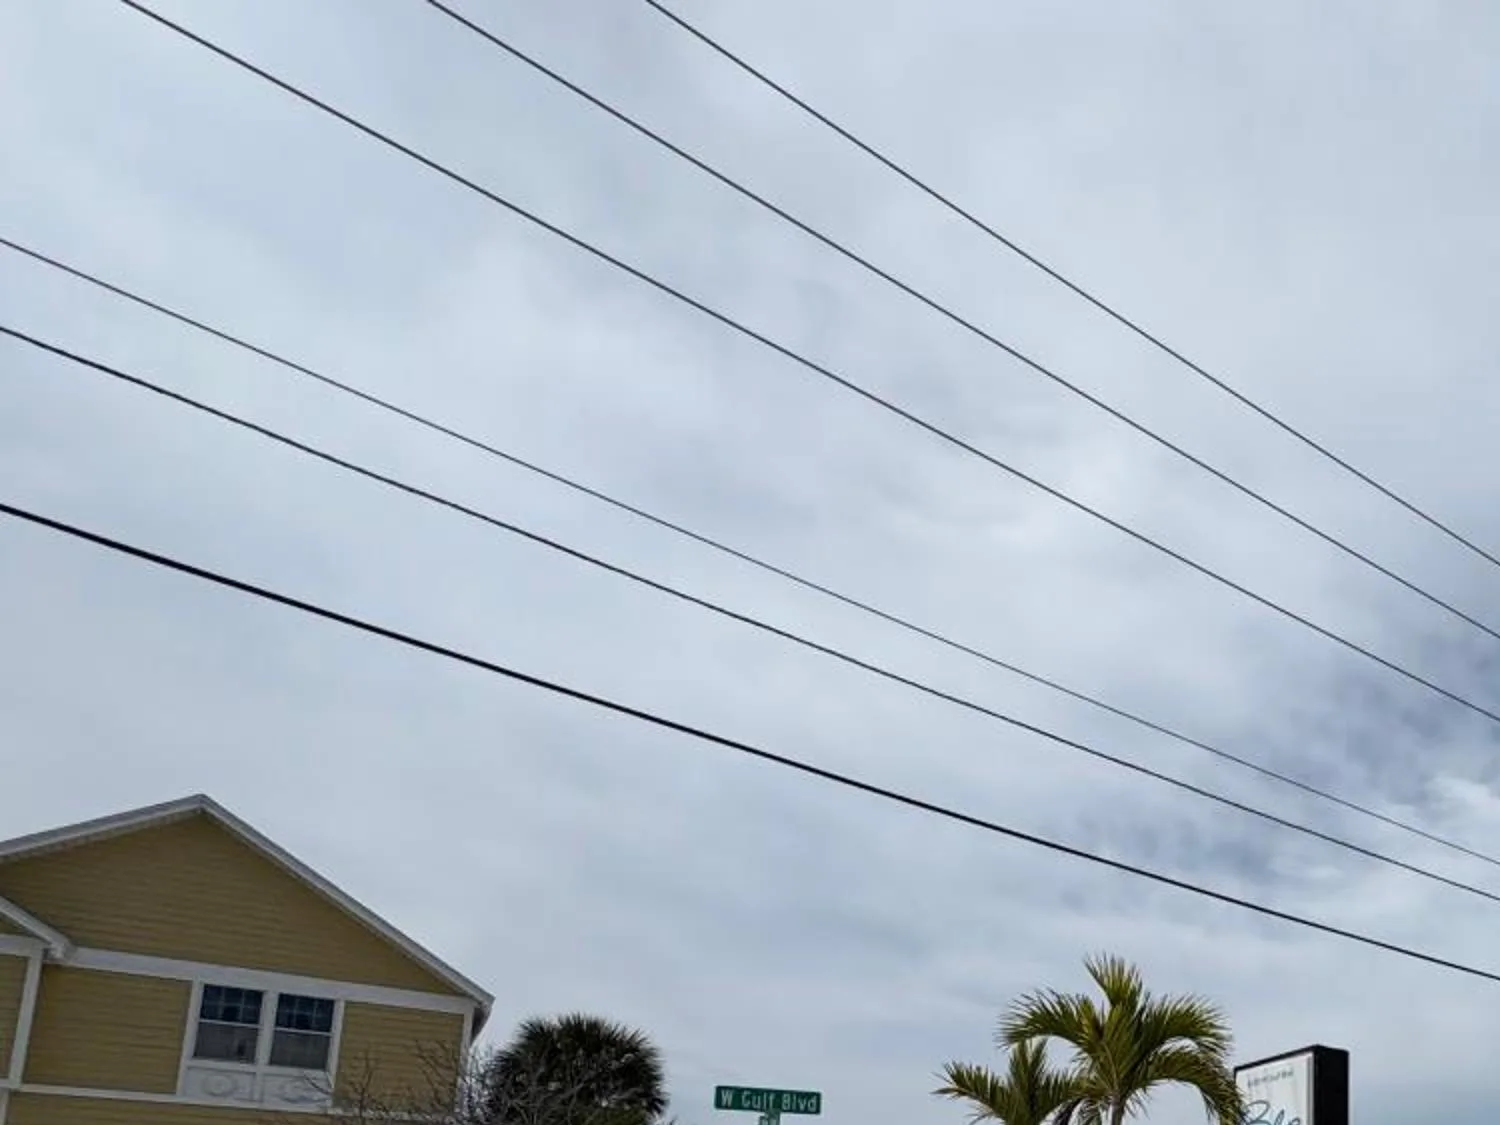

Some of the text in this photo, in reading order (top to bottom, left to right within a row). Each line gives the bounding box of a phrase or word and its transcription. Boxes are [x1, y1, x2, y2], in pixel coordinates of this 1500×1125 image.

[721, 1089, 818, 1112] W Gulf Blvd
